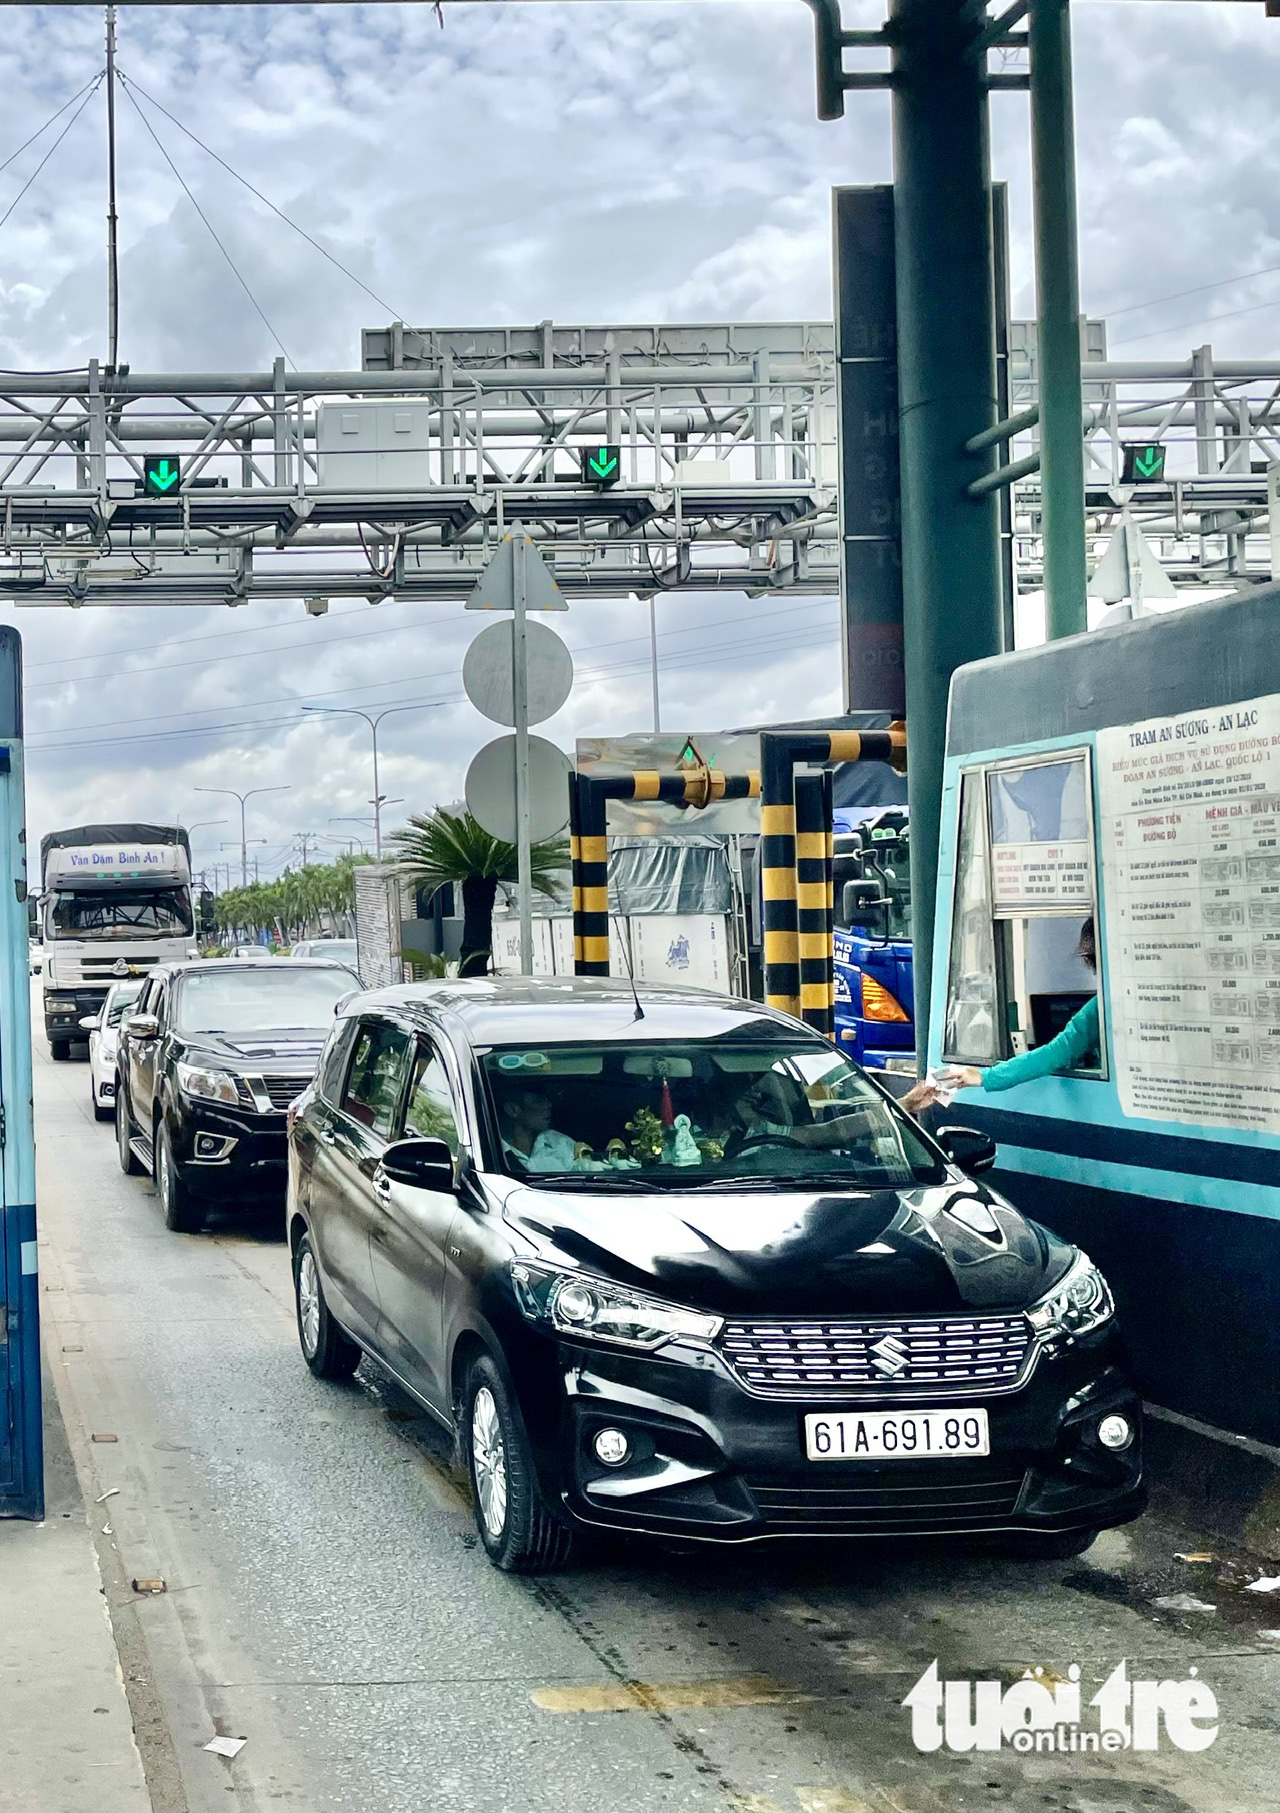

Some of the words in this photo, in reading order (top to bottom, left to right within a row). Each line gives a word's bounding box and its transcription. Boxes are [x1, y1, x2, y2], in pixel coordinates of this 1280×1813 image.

[1129, 730, 1157, 747] TRẠM
[1160, 727, 1172, 743] AN
[1176, 719, 1209, 739] SƯƠNG
[1219, 715, 1233, 732] AN
[1237, 710, 1258, 731] LẠC
[1146, 768, 1157, 780] AN
[814, 1417, 980, 1453] 61A-691.89
